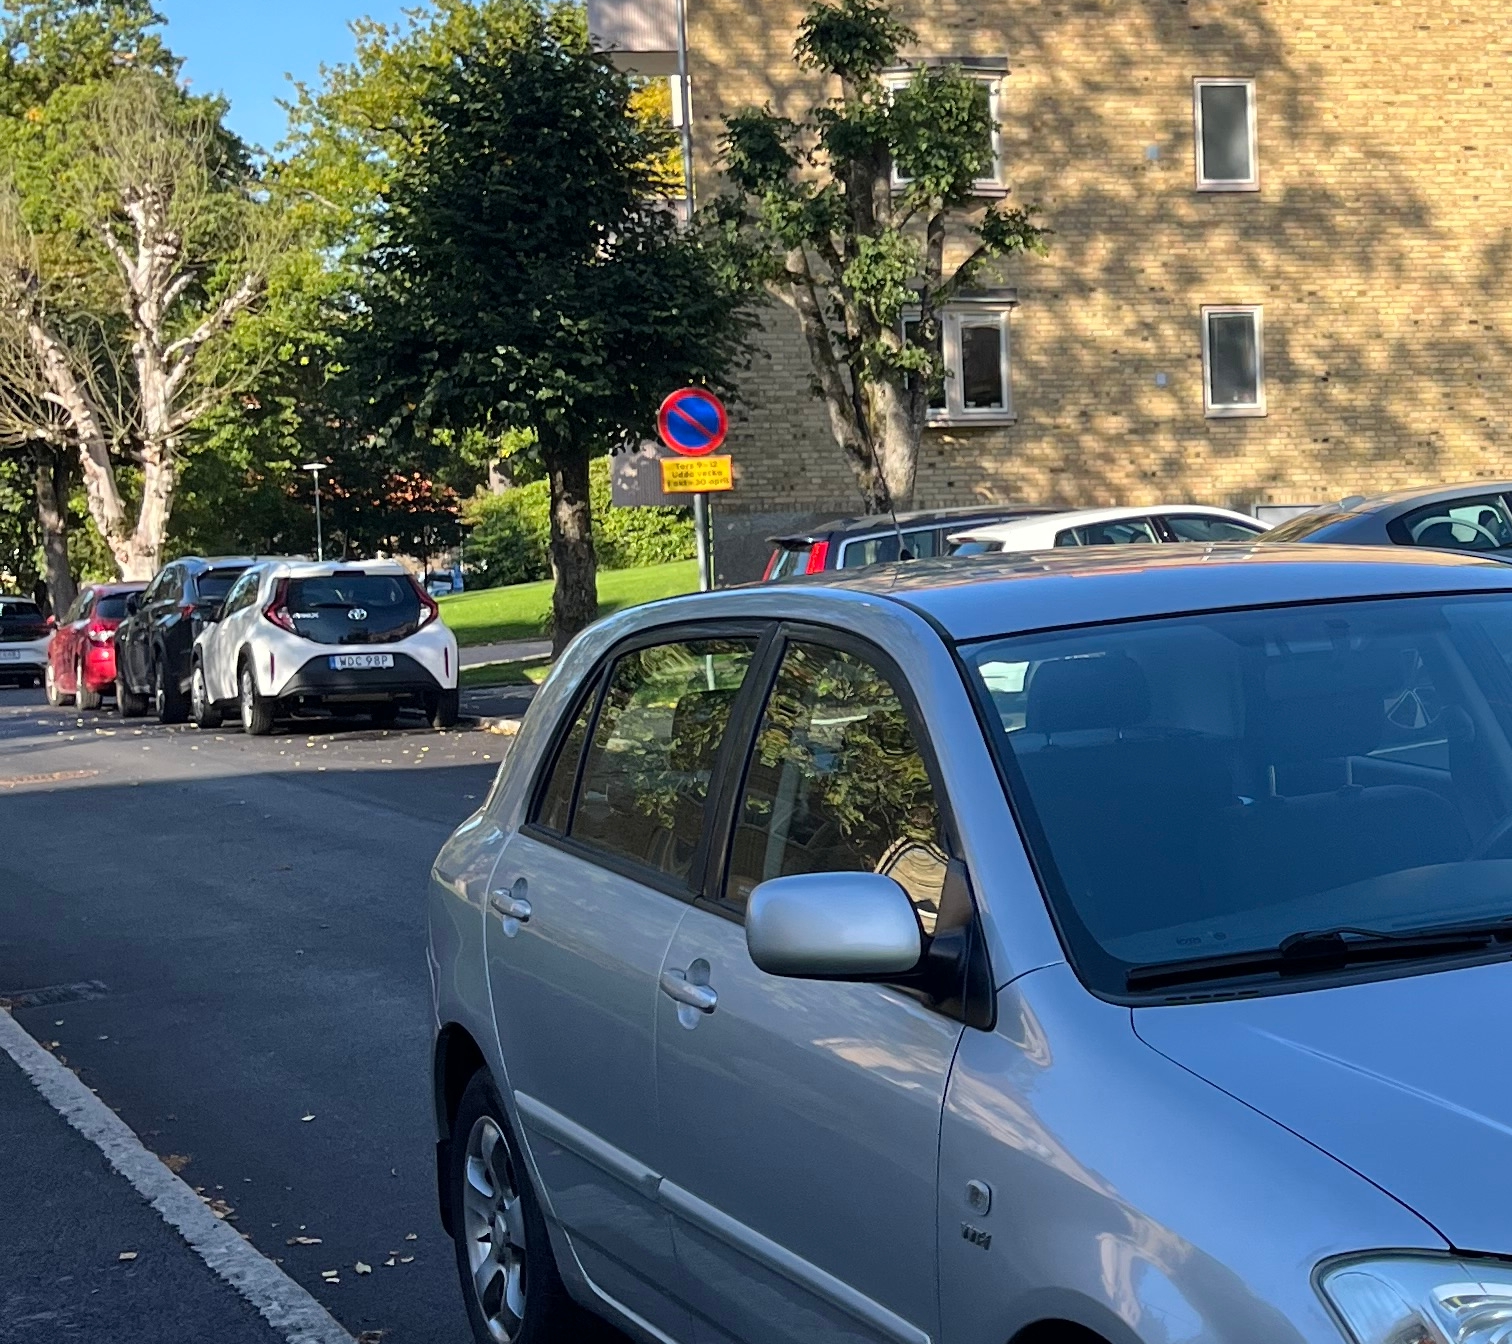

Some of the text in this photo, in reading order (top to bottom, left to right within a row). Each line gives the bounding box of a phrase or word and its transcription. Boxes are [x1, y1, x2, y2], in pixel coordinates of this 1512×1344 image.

[675, 462, 694, 470] Tors
[671, 469, 723, 479] Udda vecka
[339, 655, 388, 666] WDC 98P
